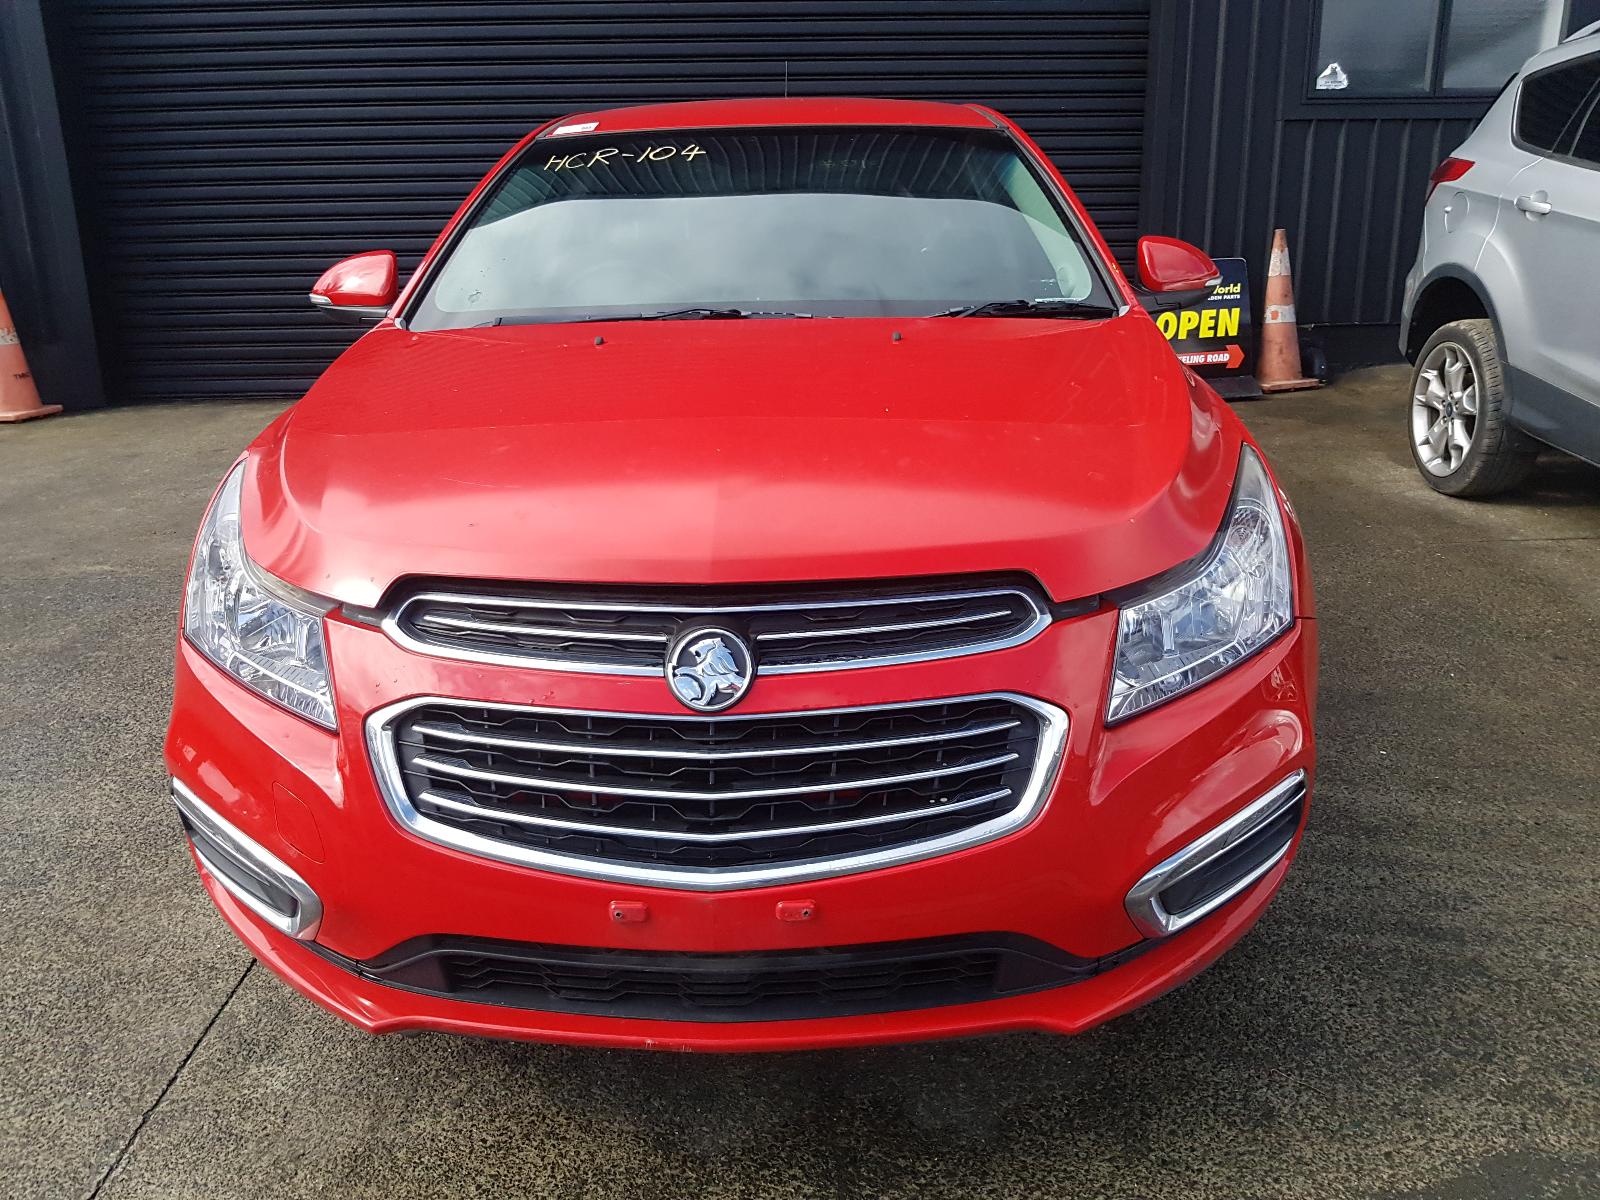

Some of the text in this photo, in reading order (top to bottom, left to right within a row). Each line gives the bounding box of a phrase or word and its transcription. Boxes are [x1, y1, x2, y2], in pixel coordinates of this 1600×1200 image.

[543, 144, 706, 171] HCR-104
[1156, 308, 1240, 340] OPEN
[1206, 353, 1230, 363] ROAD
